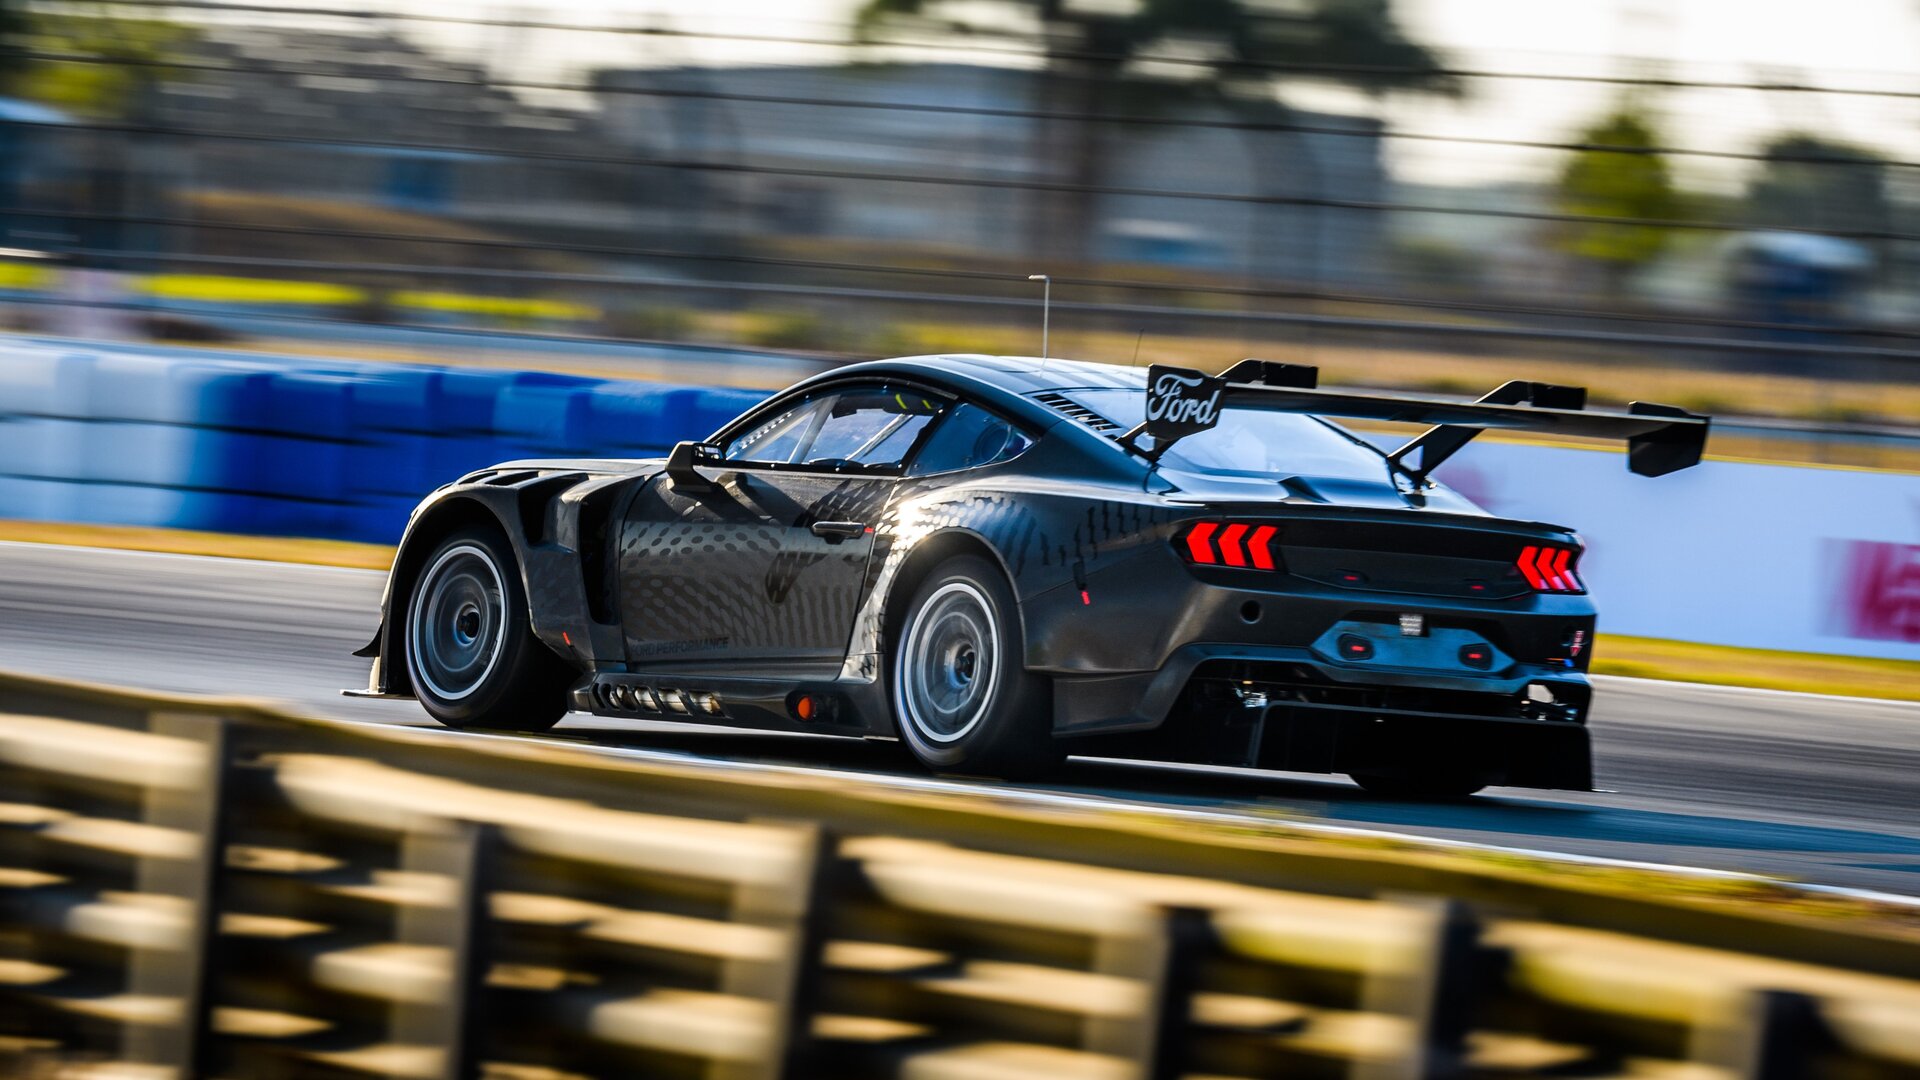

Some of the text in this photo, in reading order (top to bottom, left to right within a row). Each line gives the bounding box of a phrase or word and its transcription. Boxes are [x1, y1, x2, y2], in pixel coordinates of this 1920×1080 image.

[1147, 373, 1220, 425] Ford
[631, 637, 729, 657] FORD PERFORMANCE
